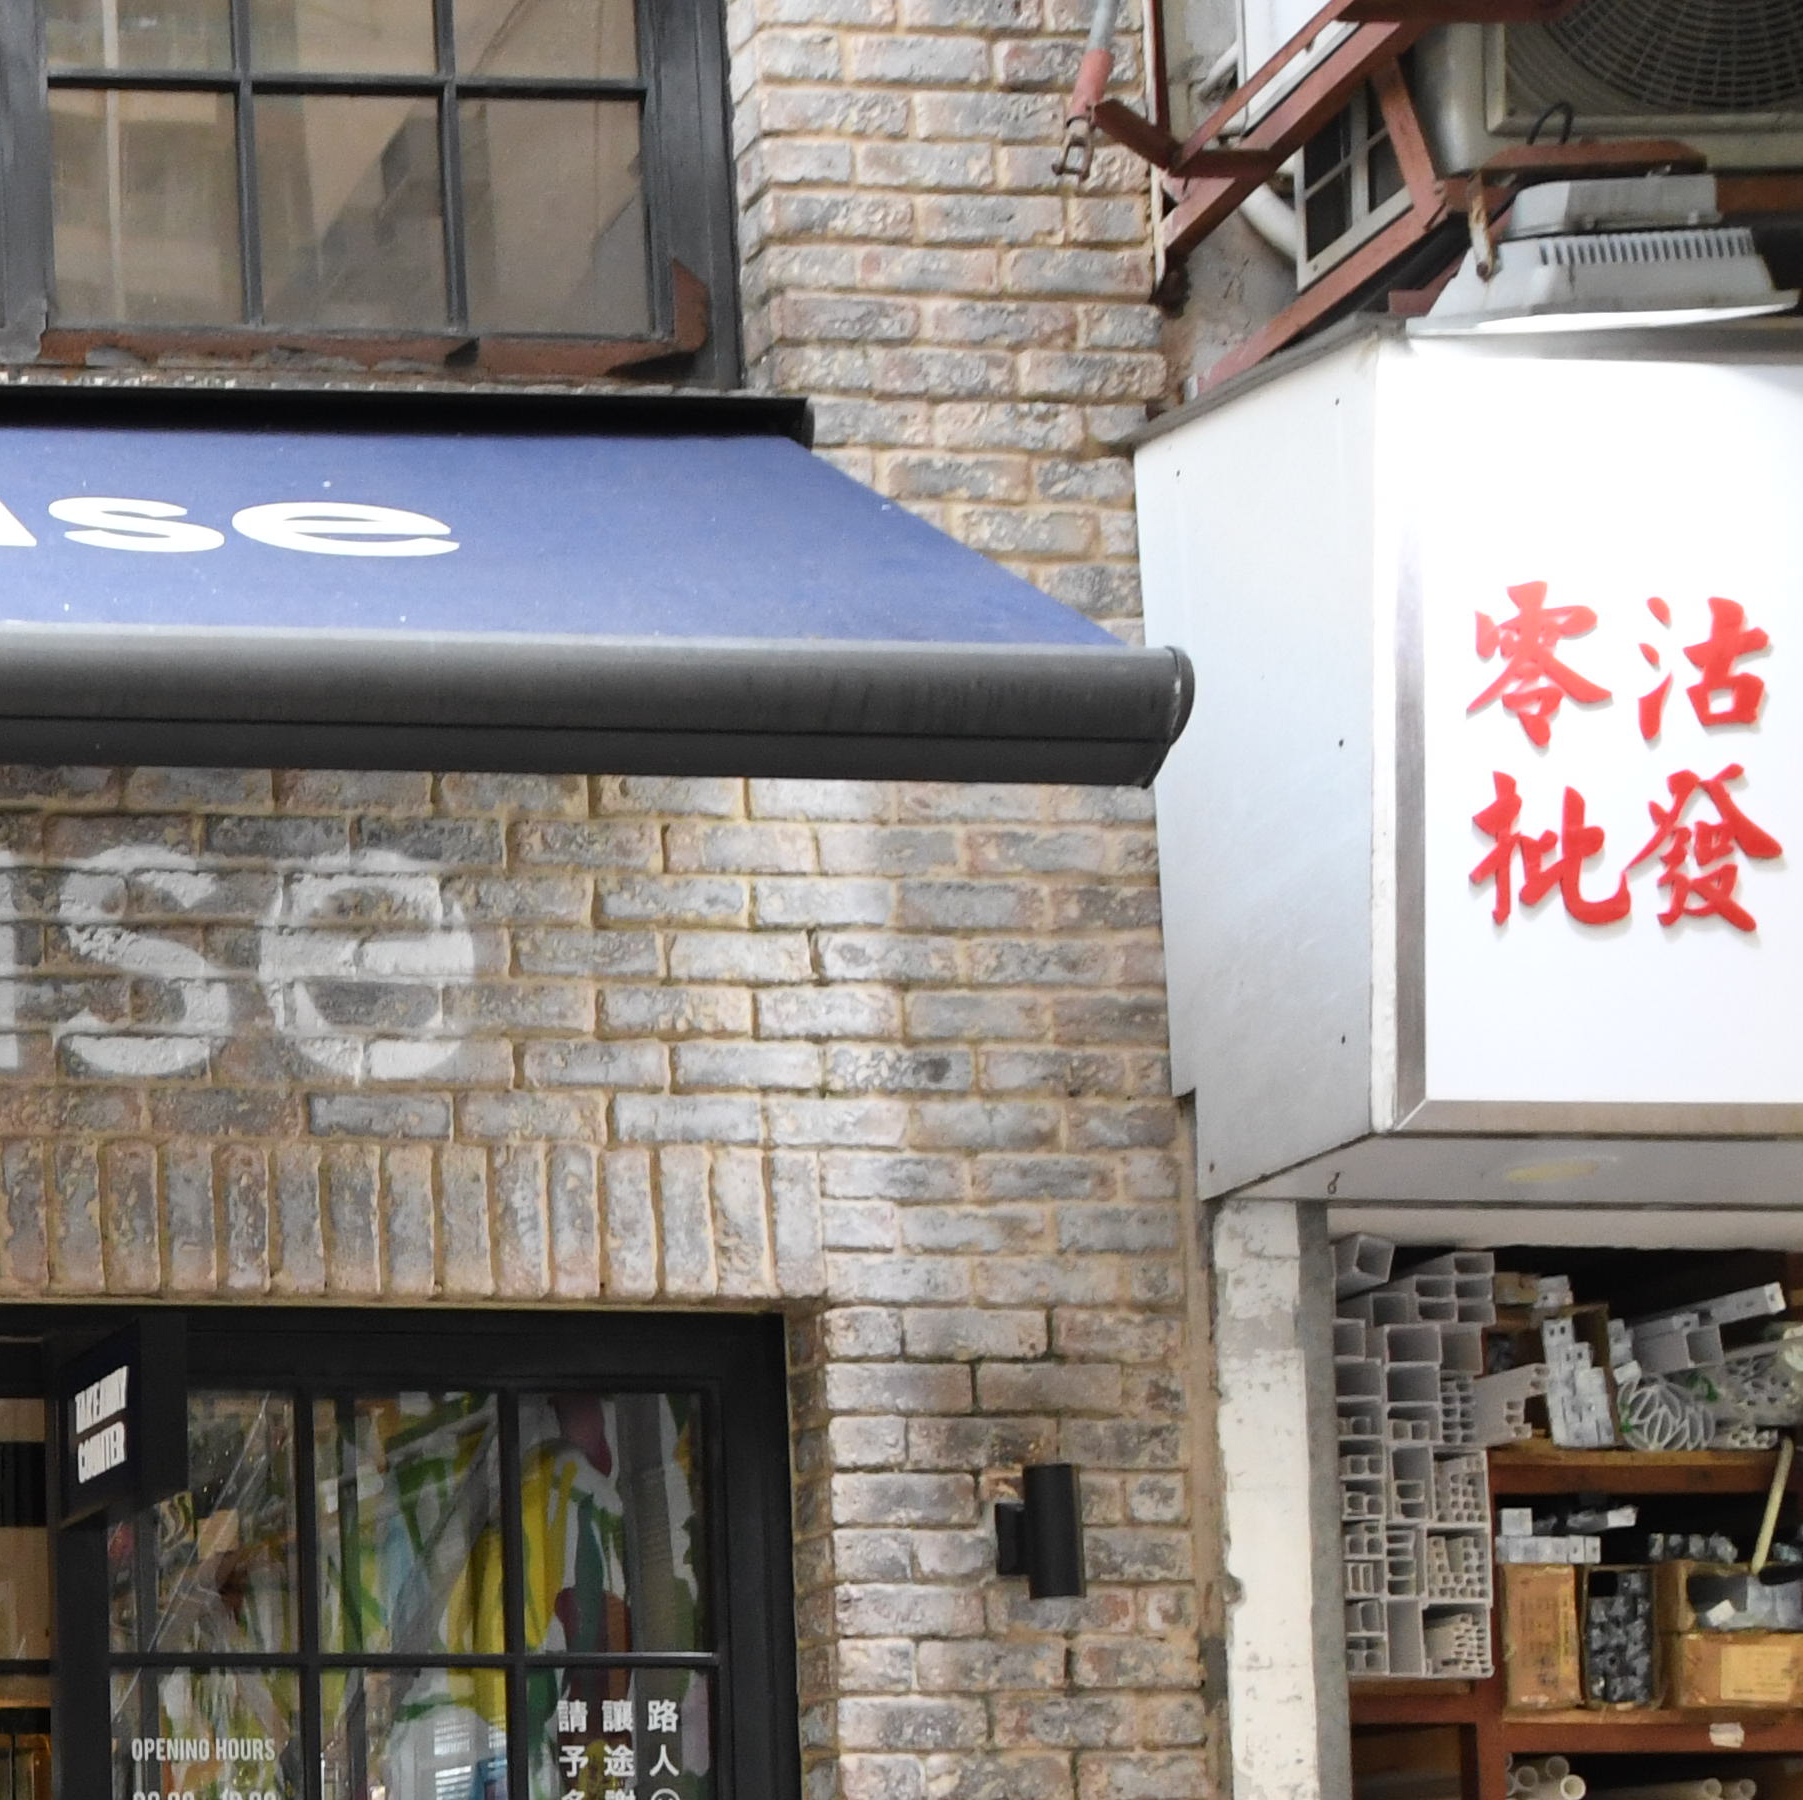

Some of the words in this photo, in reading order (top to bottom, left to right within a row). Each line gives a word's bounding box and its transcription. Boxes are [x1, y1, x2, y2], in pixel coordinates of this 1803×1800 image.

[1466, 581, 1771, 748] 零沽
[1470, 763, 1783, 933] 批發
[557, 1699, 679, 1733] 請讓路
[132, 1738, 209, 1761] OPENING
[215, 1738, 275, 1761] HOURS
[559, 1744, 680, 1778] 予途人
